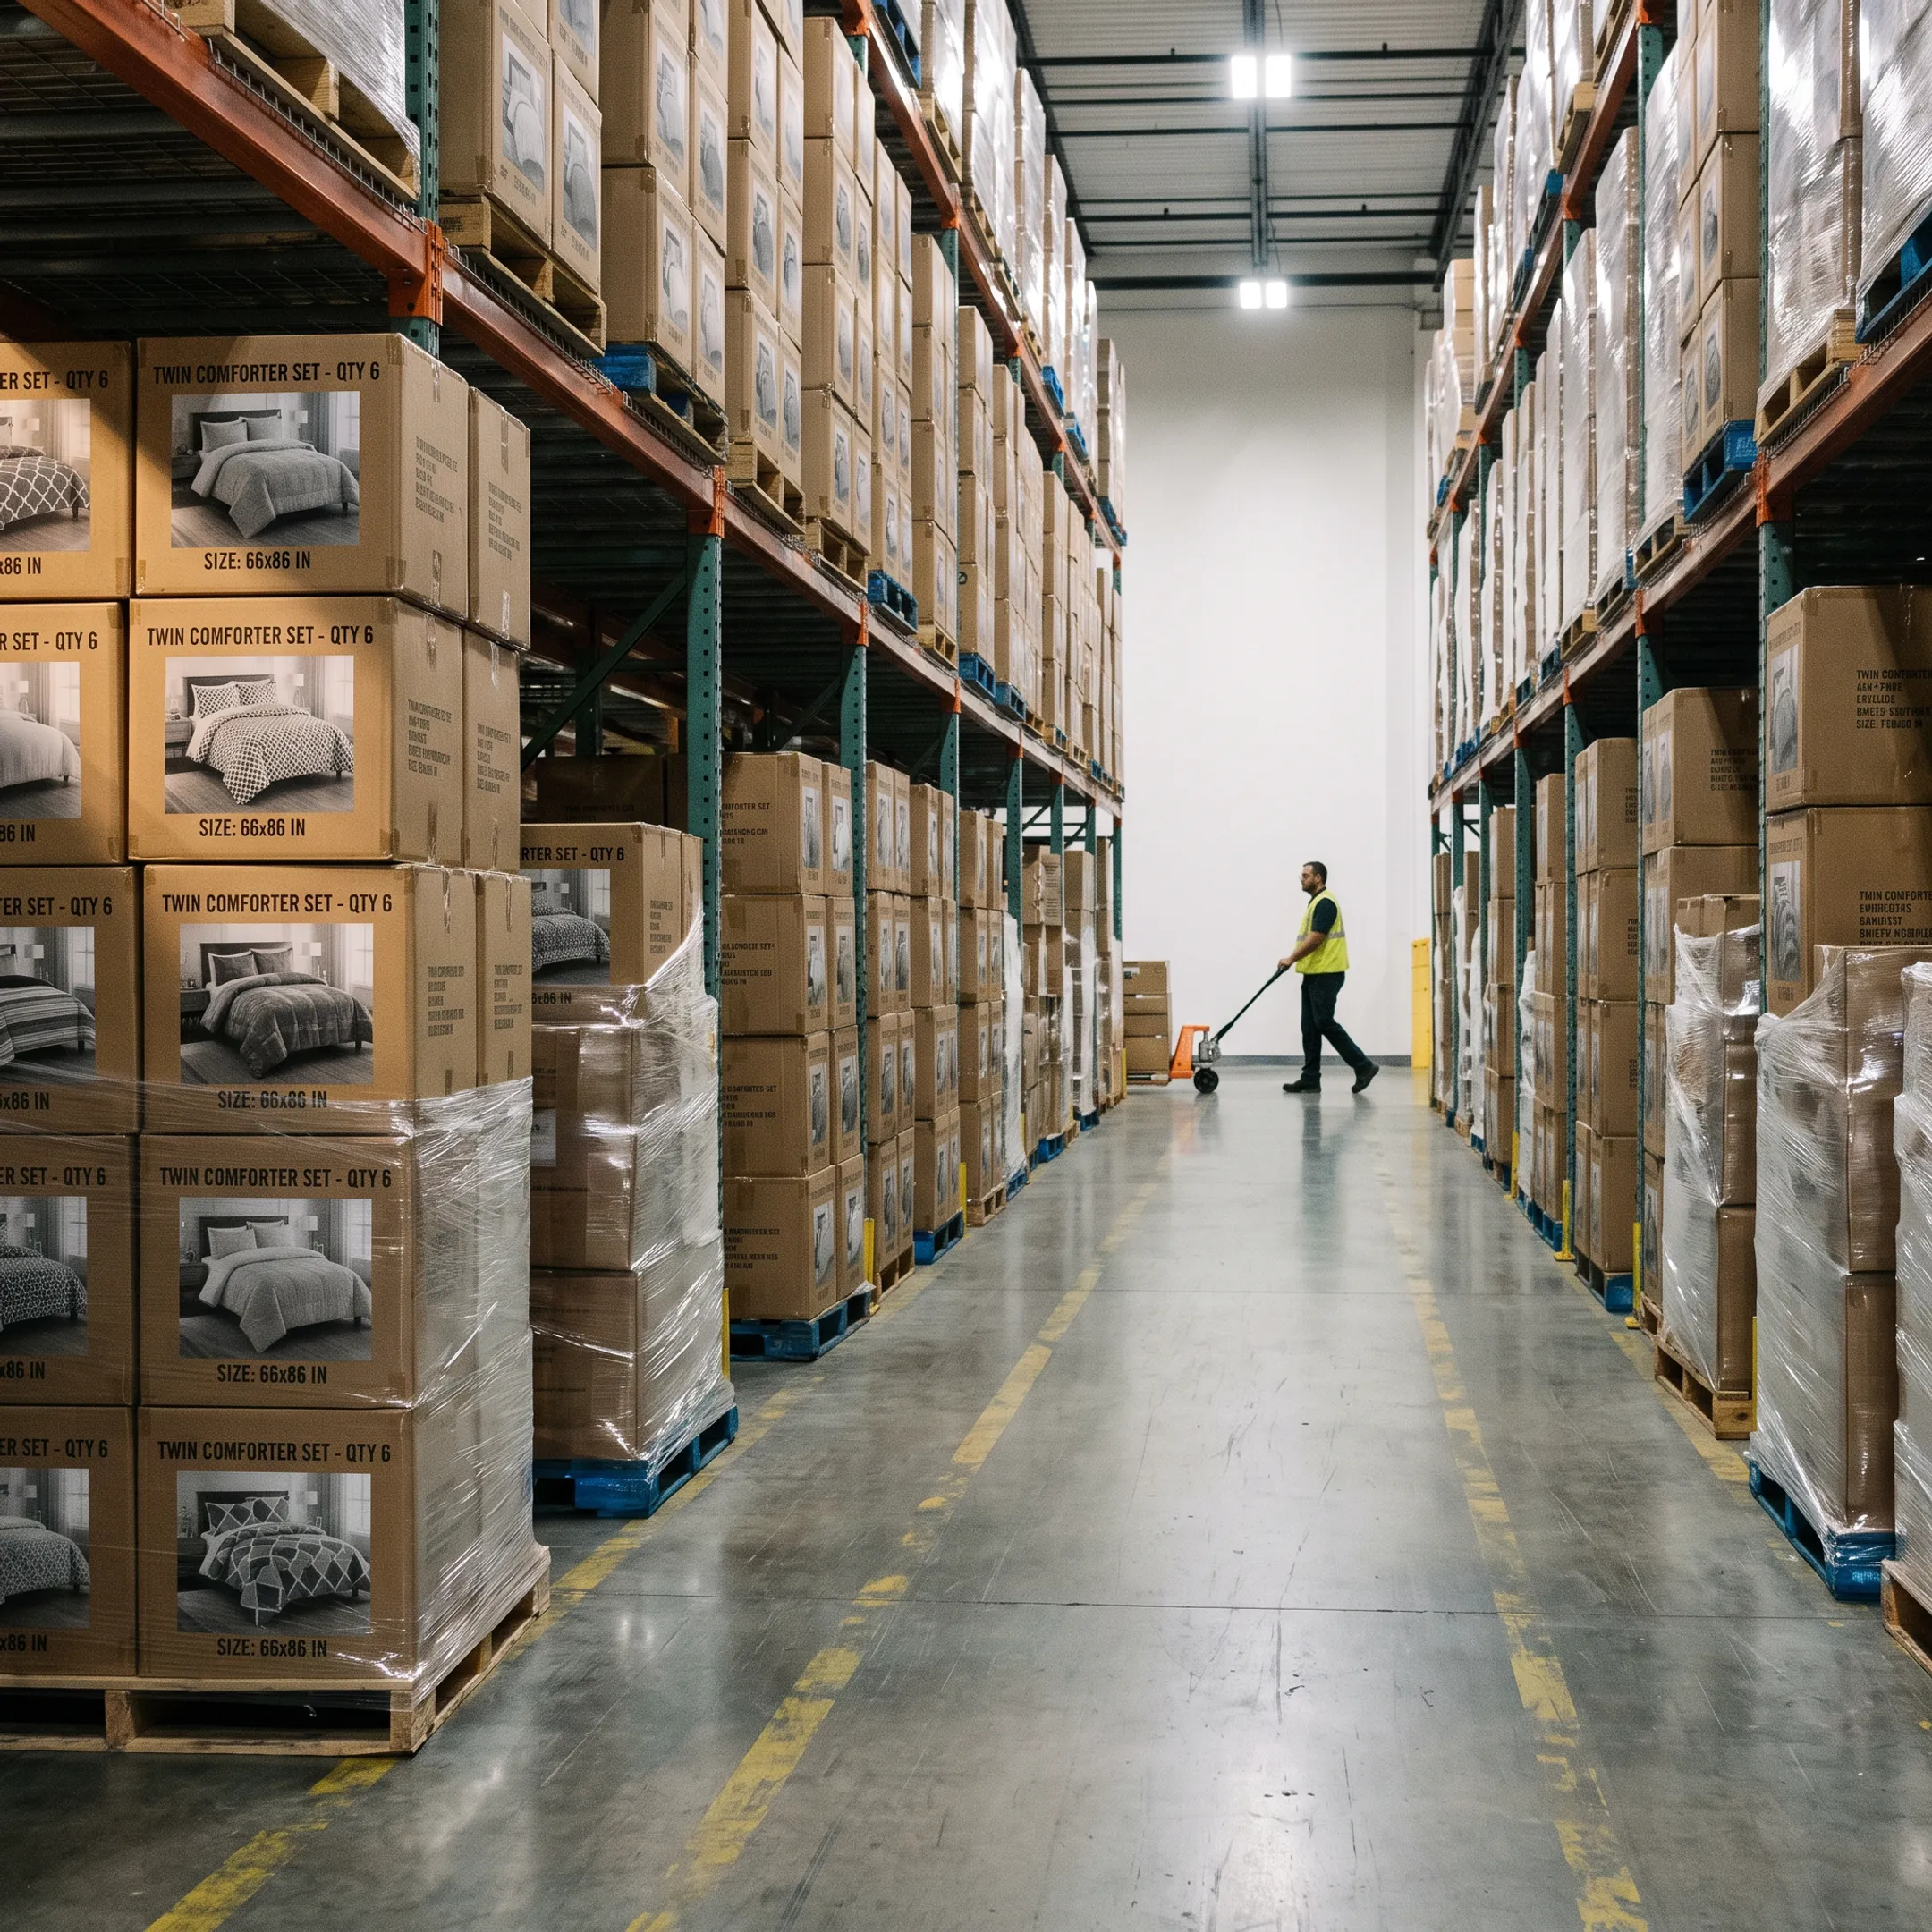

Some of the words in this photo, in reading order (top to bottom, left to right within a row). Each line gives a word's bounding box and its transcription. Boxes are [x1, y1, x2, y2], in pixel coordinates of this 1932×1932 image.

[24, 371, 49, 389] SET
[66, 369, 94, 390] QTY
[98, 369, 108, 389] 6
[153, 365, 191, 385] TWIN
[196, 363, 288, 384] COMFORTER
[292, 362, 321, 382] SET
[336, 361, 366, 382] QTY
[369, 361, 380, 381] 6
[27, 556, 41, 575] IN
[204, 552, 241, 570] SIZE:
[246, 551, 291, 570] 66x86
[295, 550, 311, 570] IN
[13, 631, 40, 651] SET
[55, 631, 83, 652] QTY
[89, 631, 97, 650] 6
[147, 627, 184, 646] TWIN
[190, 626, 282, 646] COMFORTER
[286, 625, 315, 645] SET
[330, 624, 360, 646] QTY
[363, 624, 374, 645] 6
[21, 824, 36, 843] IN
[199, 818, 236, 837] SIZE:
[241, 818, 285, 837] 66x86
[291, 818, 305, 837] IN
[521, 846, 552, 861] RTER
[555, 847, 578, 861] SET
[589, 846, 614, 863] QTY
[616, 846, 624, 861] 6
[0, 897, 22, 916] ER
[27, 897, 55, 916] SET
[70, 896, 98, 917] QTY
[102, 896, 113, 916] 6
[162, 894, 201, 913] TWIN
[206, 894, 300, 913] COMFORTER
[304, 894, 333, 912] SET
[349, 894, 378, 914] QTY
[382, 894, 393, 912] 6
[560, 992, 572, 1004] IN
[0, 1091, 30, 1111] x86
[34, 1091, 50, 1111] IN
[20, 1166, 48, 1186] SET
[63, 1166, 93, 1186] QTY
[97, 1166, 106, 1186] 6
[159, 1166, 199, 1186] TWIN
[204, 1167, 298, 1187] COMFORTER
[302, 1168, 332, 1188] SET
[347, 1168, 377, 1189] QTY
[382, 1168, 392, 1189] 6
[30, 1360, 46, 1380] IN
[216, 1363, 256, 1383] SIZE:
[259, 1364, 307, 1384] 66x86
[311, 1365, 327, 1384] IN
[21, 1437, 50, 1457] SET
[64, 1438, 95, 1459] QTY
[98, 1439, 108, 1458] 6
[157, 1440, 198, 1460] TWIN
[202, 1441, 298, 1462] COMFORTER
[301, 1442, 331, 1462] SET
[346, 1443, 377, 1463] QTY
[381, 1444, 391, 1462] 6
[31, 1633, 47, 1652] IN
[216, 1637, 256, 1657] SIZE:
[259, 1639, 307, 1657] 66x86
[311, 1640, 327, 1657] IN
